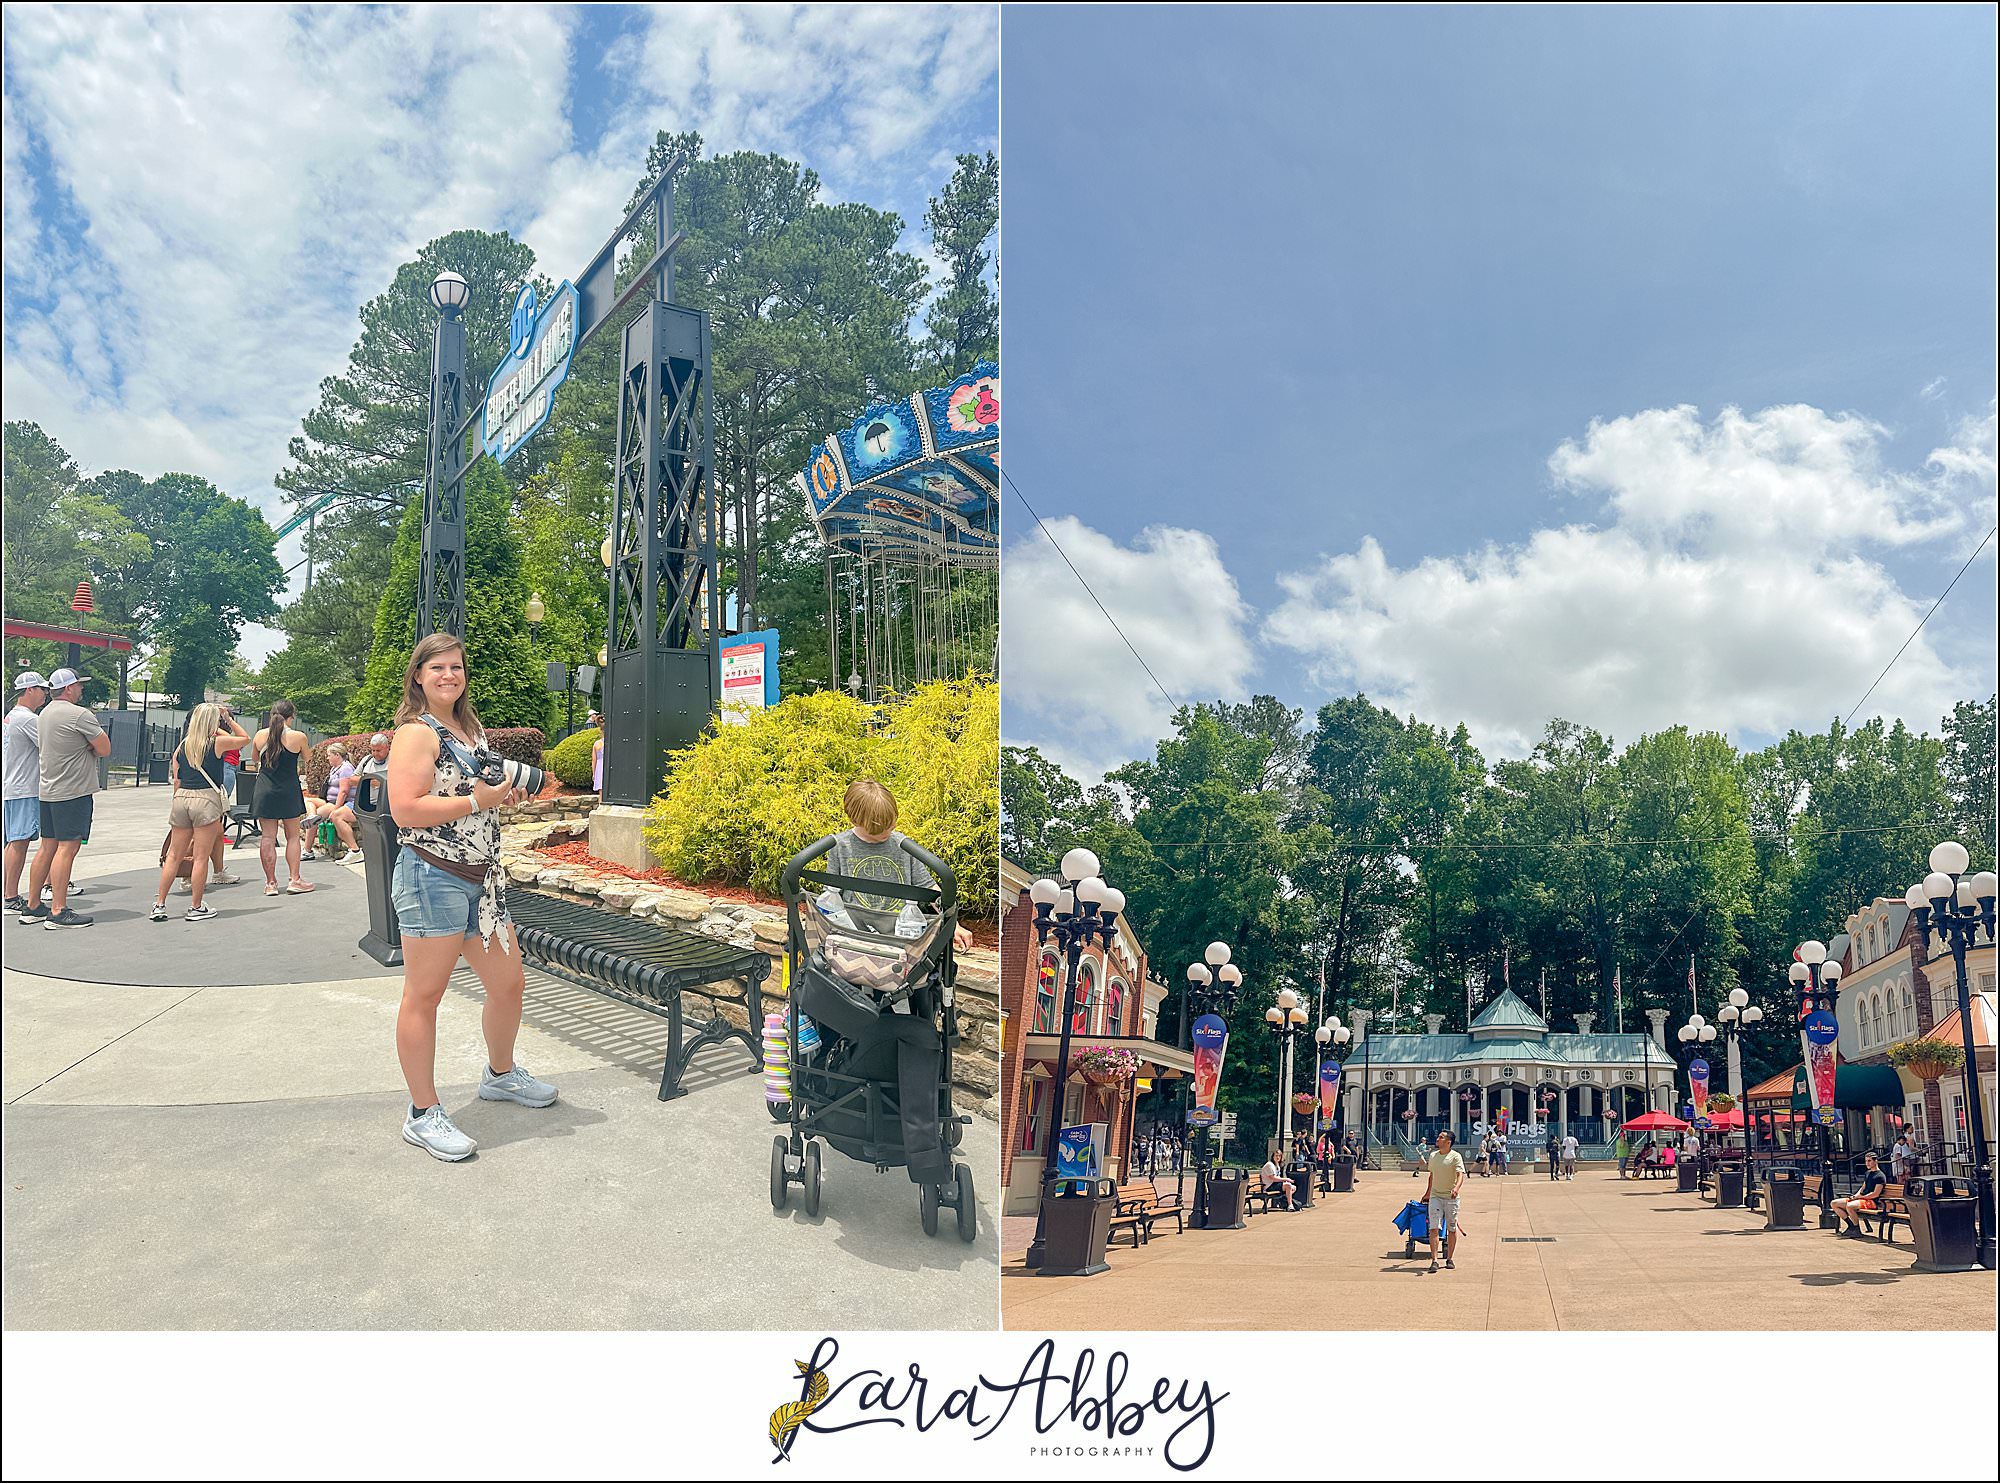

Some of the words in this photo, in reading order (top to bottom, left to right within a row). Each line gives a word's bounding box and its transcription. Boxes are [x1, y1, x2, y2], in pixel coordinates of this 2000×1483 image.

[510, 294, 535, 350] DC
[503, 389, 546, 452] SWING
[1473, 1121, 1497, 1135] Six
[1507, 1120, 1546, 1138] Flags
